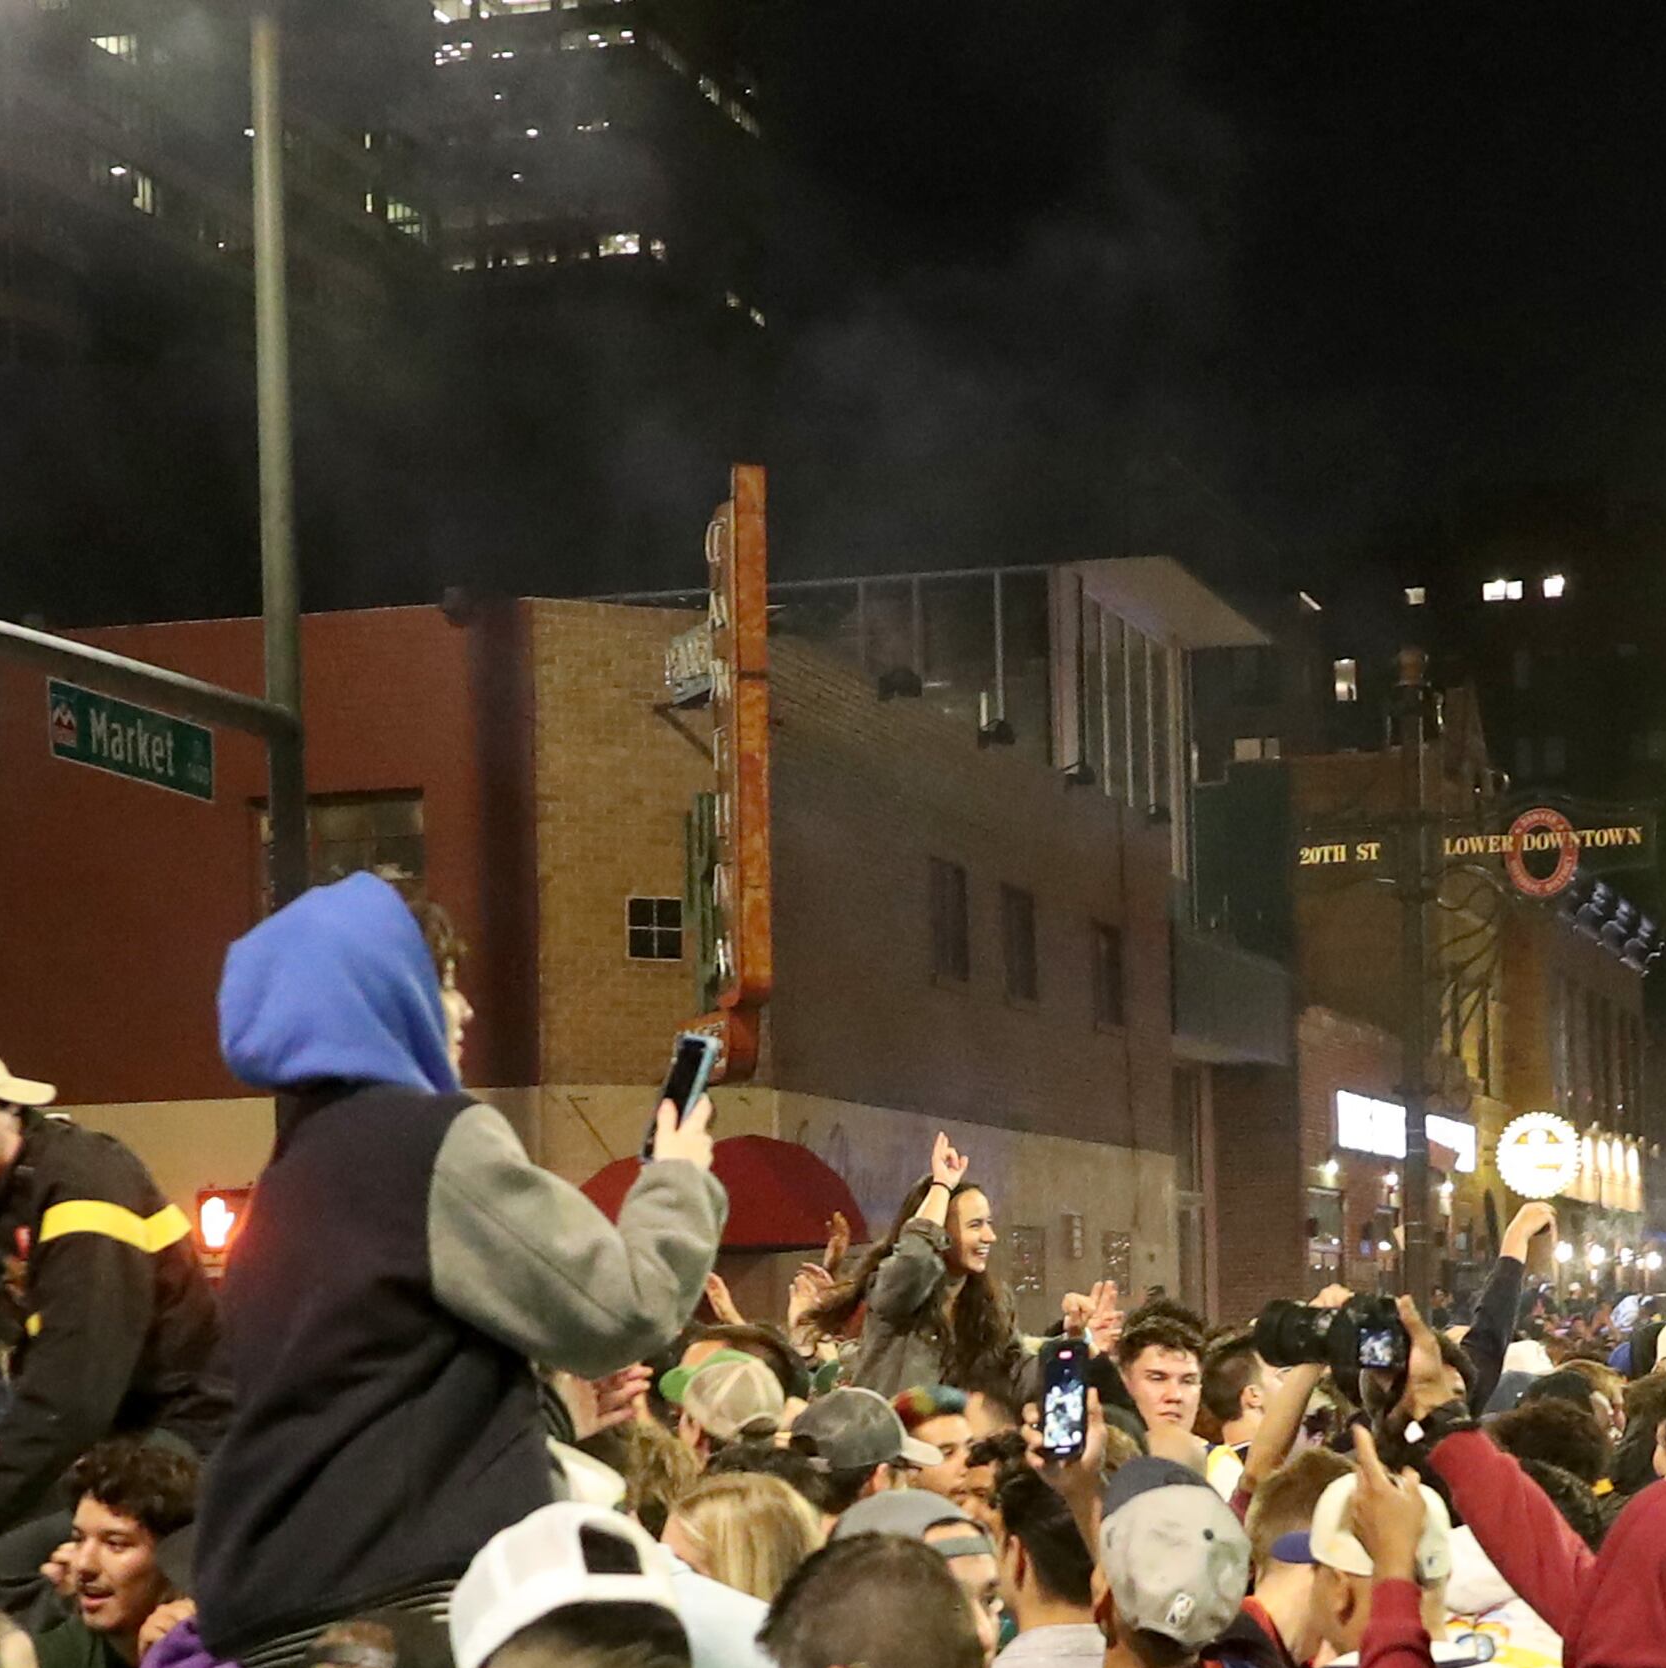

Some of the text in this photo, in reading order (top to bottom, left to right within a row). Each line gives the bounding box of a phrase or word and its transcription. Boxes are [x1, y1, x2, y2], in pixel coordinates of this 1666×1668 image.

[88, 707, 175, 777] Market
[1299, 841, 1381, 865] 20TH ST
[1444, 825, 1643, 856] LOWER DOWNTOWN
